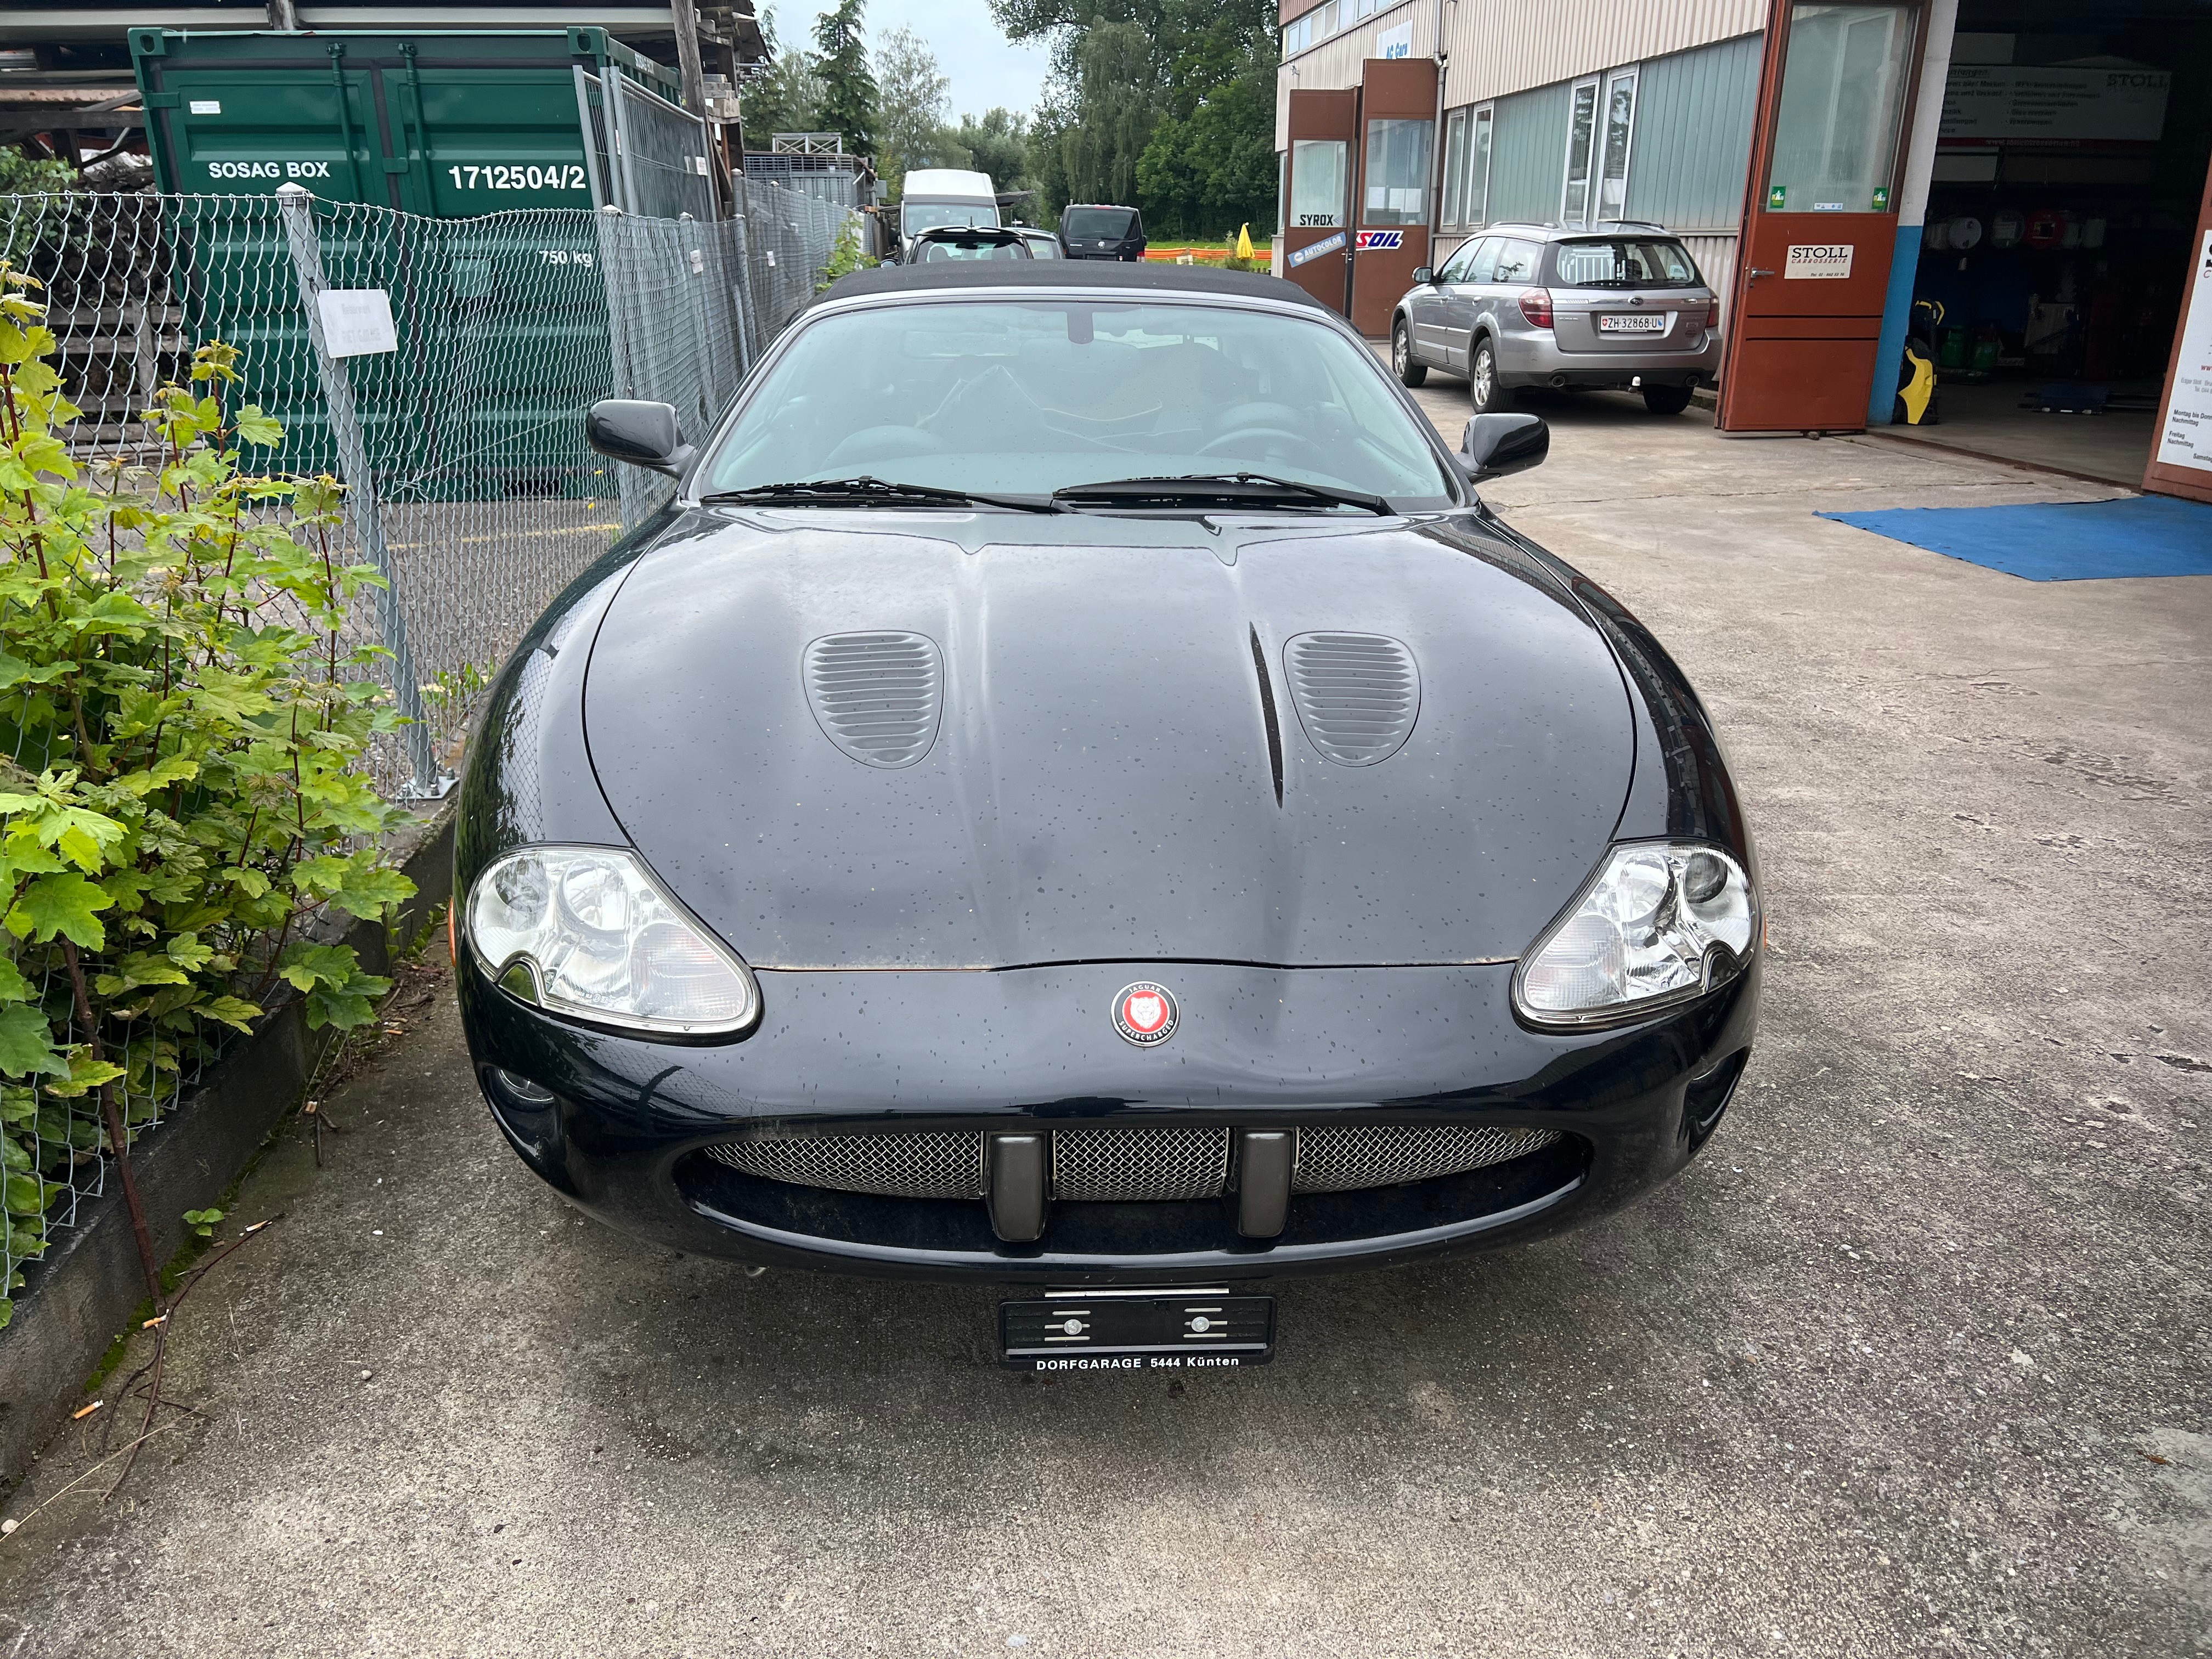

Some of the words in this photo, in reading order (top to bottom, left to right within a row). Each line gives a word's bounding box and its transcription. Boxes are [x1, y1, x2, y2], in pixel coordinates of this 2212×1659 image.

[2107, 73, 2169, 88] STOLL
[208, 162, 281, 178] SOSAG
[286, 161, 331, 178] BOX
[448, 165, 586, 190] 1712504/2
[1300, 214, 1334, 226] SYROX
[1304, 235, 1342, 257] AUTOCOLOR
[1791, 247, 1848, 258] STOLL
[539, 250, 568, 264] 750
[573, 250, 593, 268] kg
[2174, 409, 2191, 418] Montag
[2172, 417, 2199, 427] Nachmittag
[2169, 431, 2185, 439] Freitag
[2167, 438, 2194, 449] Nachmittag
[1128, 984, 1161, 994] JAGUAR
[1118, 1019, 1174, 1041] SUPERCHARGED
[1036, 1358, 1142, 1370] DORFGARAGE
[1150, 1357, 1181, 1368] 5444
[1187, 1356, 1239, 1367] Künten
